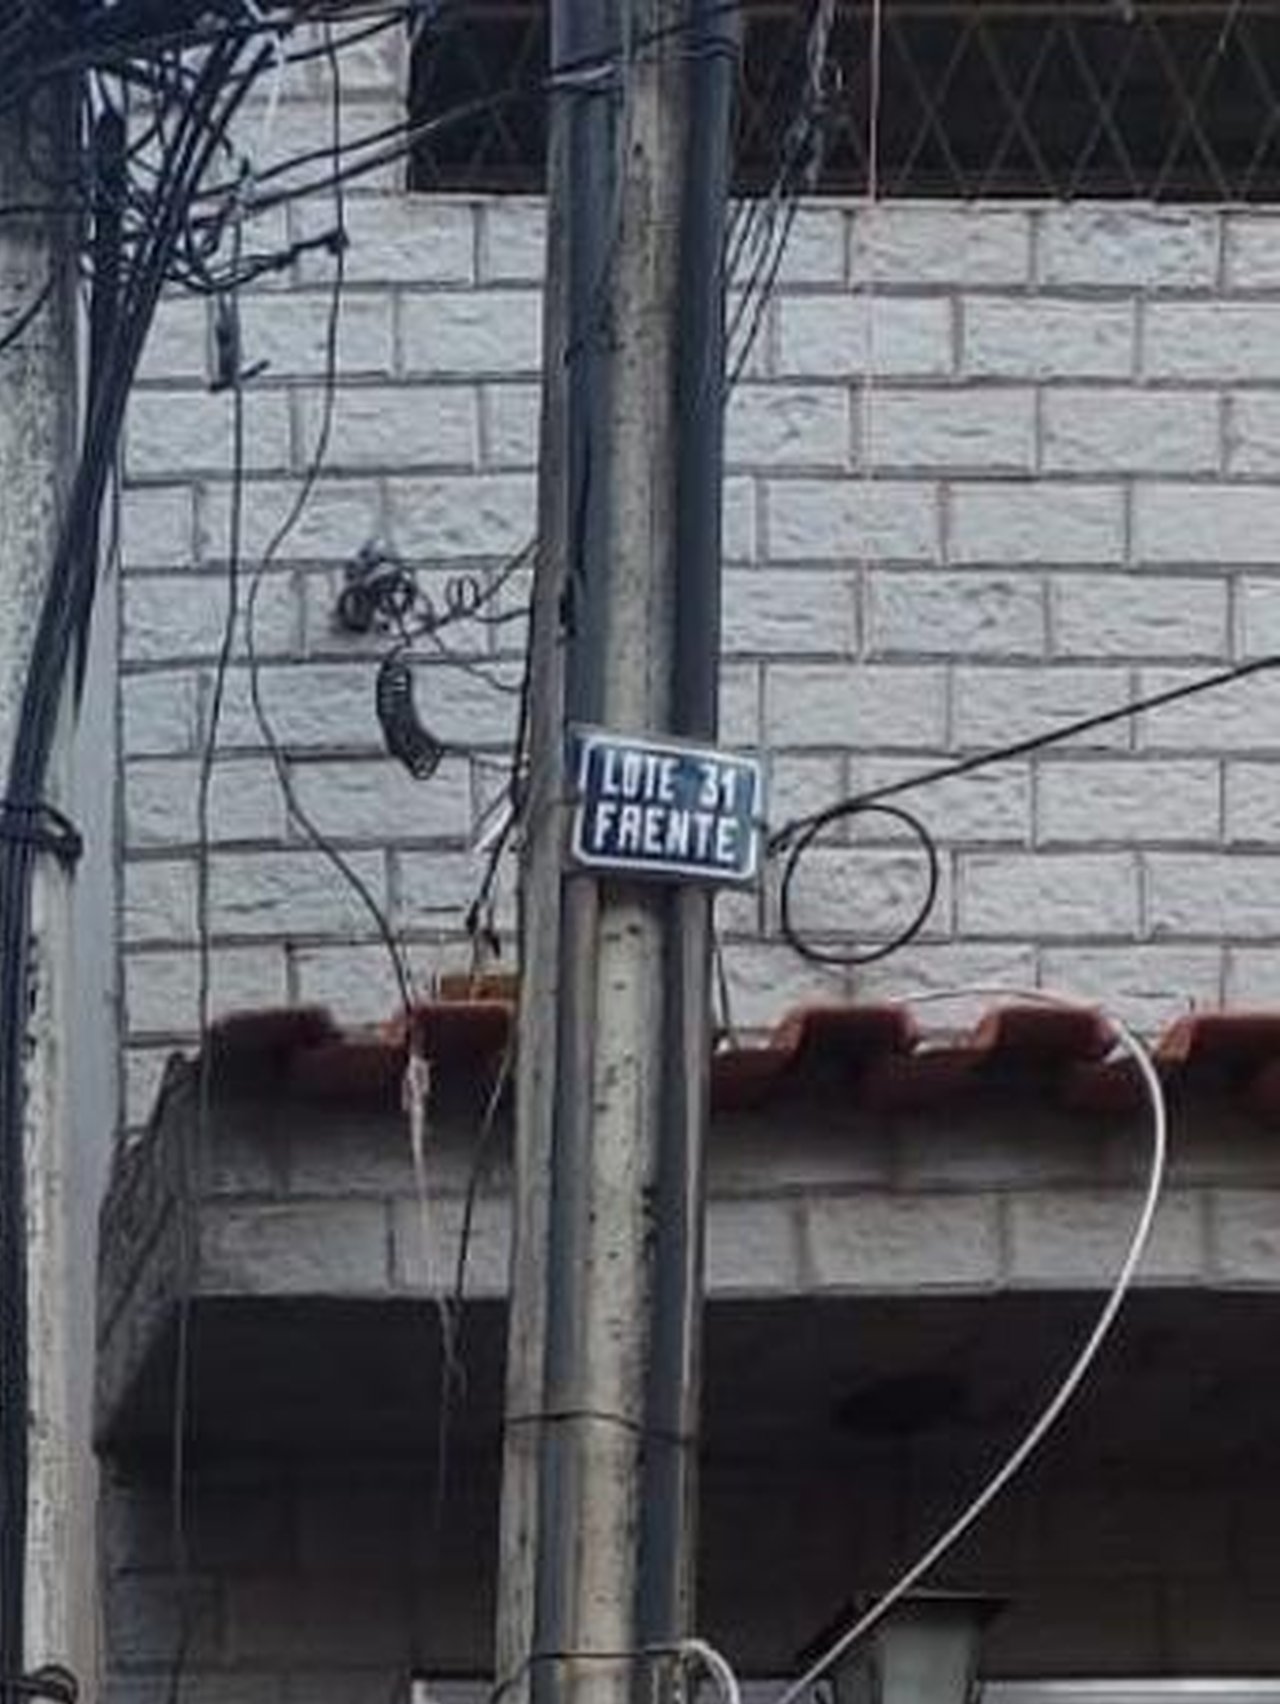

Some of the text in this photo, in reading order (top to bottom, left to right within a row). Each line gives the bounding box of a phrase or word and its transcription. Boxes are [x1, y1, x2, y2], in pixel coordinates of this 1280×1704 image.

[602, 751, 737, 809] LOTE 31
[594, 802, 740, 862] FRENTE
